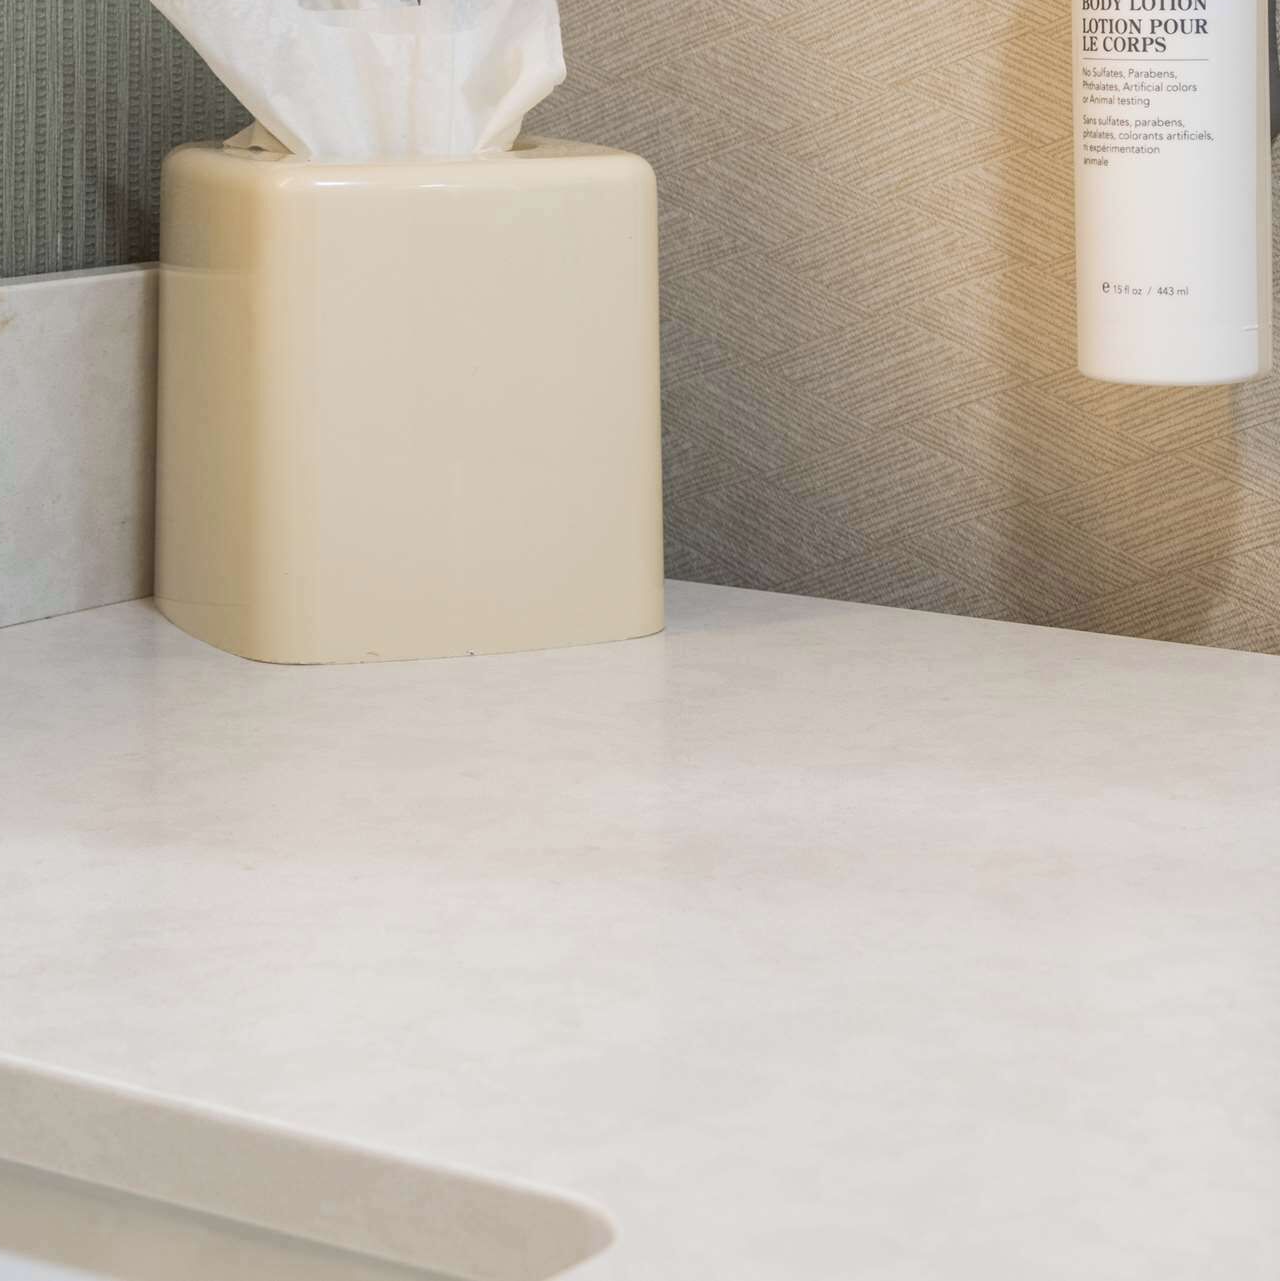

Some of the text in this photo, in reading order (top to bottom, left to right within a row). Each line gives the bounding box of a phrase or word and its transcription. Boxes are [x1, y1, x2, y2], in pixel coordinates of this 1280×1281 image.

[1082, 18, 1208, 34] LOTION POUR
[1083, 36, 1166, 52] LE CORPS
[1128, 68, 1177, 79] Parabens,
[1123, 82, 1163, 92] Artificial
[1167, 83, 1197, 92] colors
[1090, 95, 1114, 104] Animal
[1118, 98, 1150, 108] testing
[1135, 118, 1184, 128] parabens,
[1119, 132, 1164, 140] colorants
[1167, 131, 1214, 141] artificiels,
[1157, 287, 1174, 295] 443
[1177, 287, 1189, 295] ml
